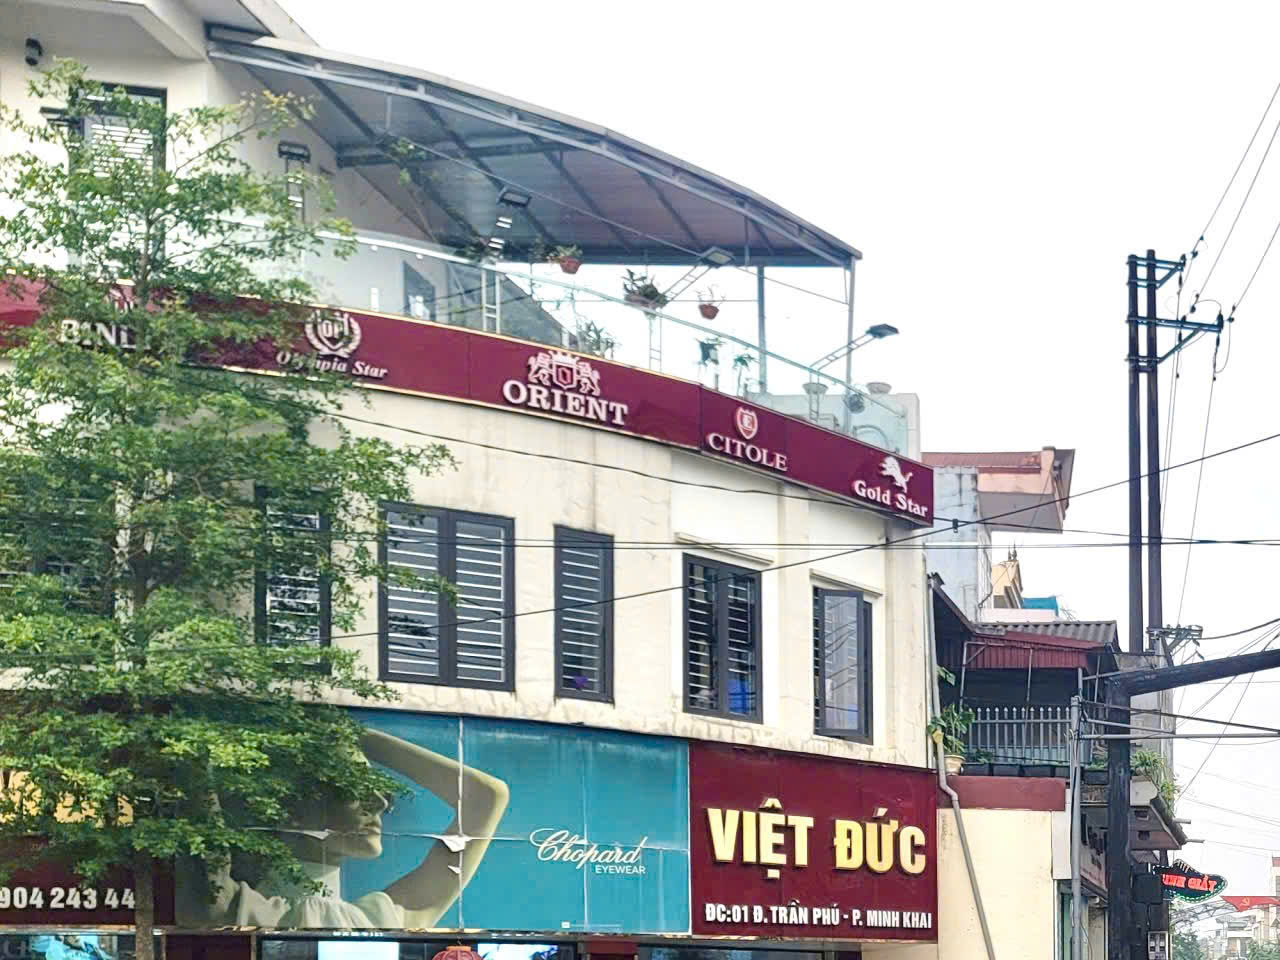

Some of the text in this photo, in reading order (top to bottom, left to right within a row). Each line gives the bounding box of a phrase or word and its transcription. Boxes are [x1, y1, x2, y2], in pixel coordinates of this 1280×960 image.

[352, 361, 388, 378] Star
[502, 380, 629, 427] ORIENT
[707, 433, 789, 472] CITOLE
[853, 479, 928, 518] Gold Star
[529, 828, 648, 869] Chopard
[707, 798, 927, 880] VIỆT ĐỨC
[595, 864, 646, 875] EYEWEAR
[49, 886, 98, 910] 243
[705, 903, 749, 924] ĐC:01
[770, 899, 808, 925] TRẦN
[812, 903, 840, 926] PHÚ
[852, 909, 862, 926] P.
[866, 909, 900, 929] MINH
[903, 911, 932, 930] KHAI
